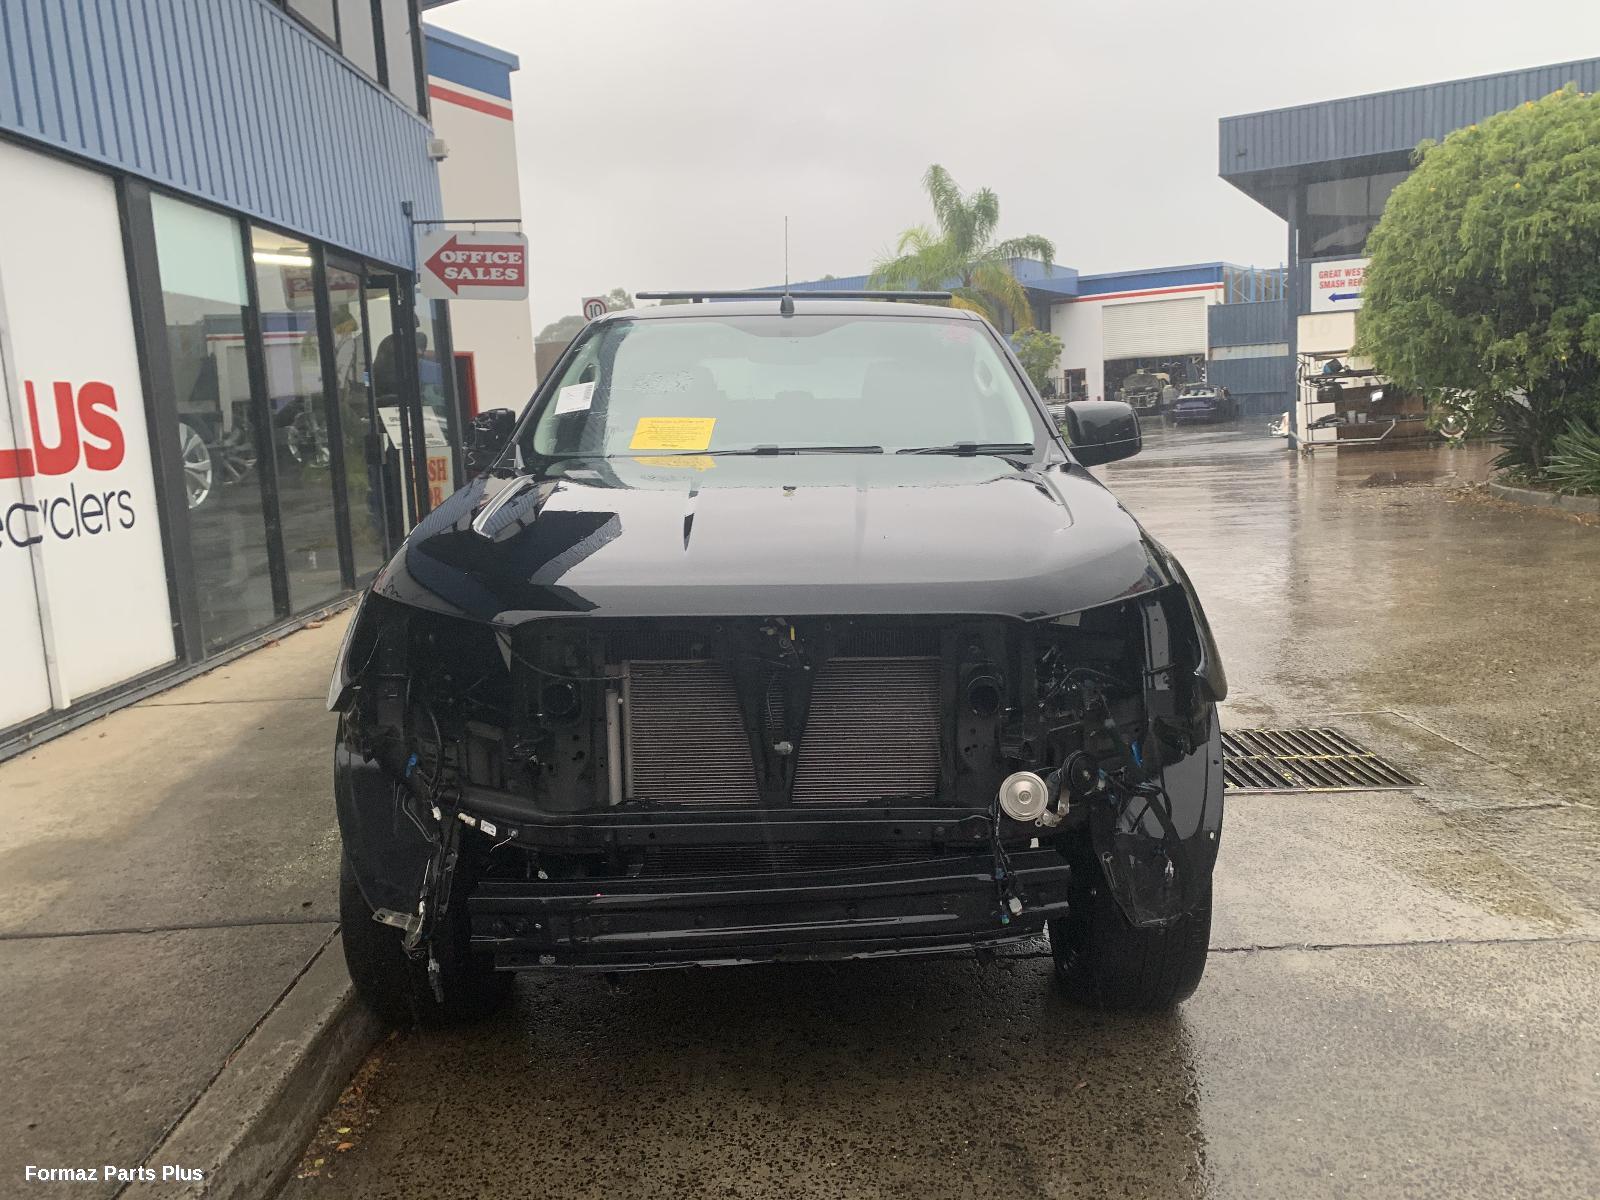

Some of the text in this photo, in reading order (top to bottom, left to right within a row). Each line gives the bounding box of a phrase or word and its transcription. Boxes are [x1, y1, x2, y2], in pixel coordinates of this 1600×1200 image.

[440, 250, 523, 264] OFFICE
[444, 267, 519, 280] SALES
[1318, 270, 1342, 279] GREAT
[1320, 280, 1345, 289] SMASH
[589, 304, 603, 318] 10
